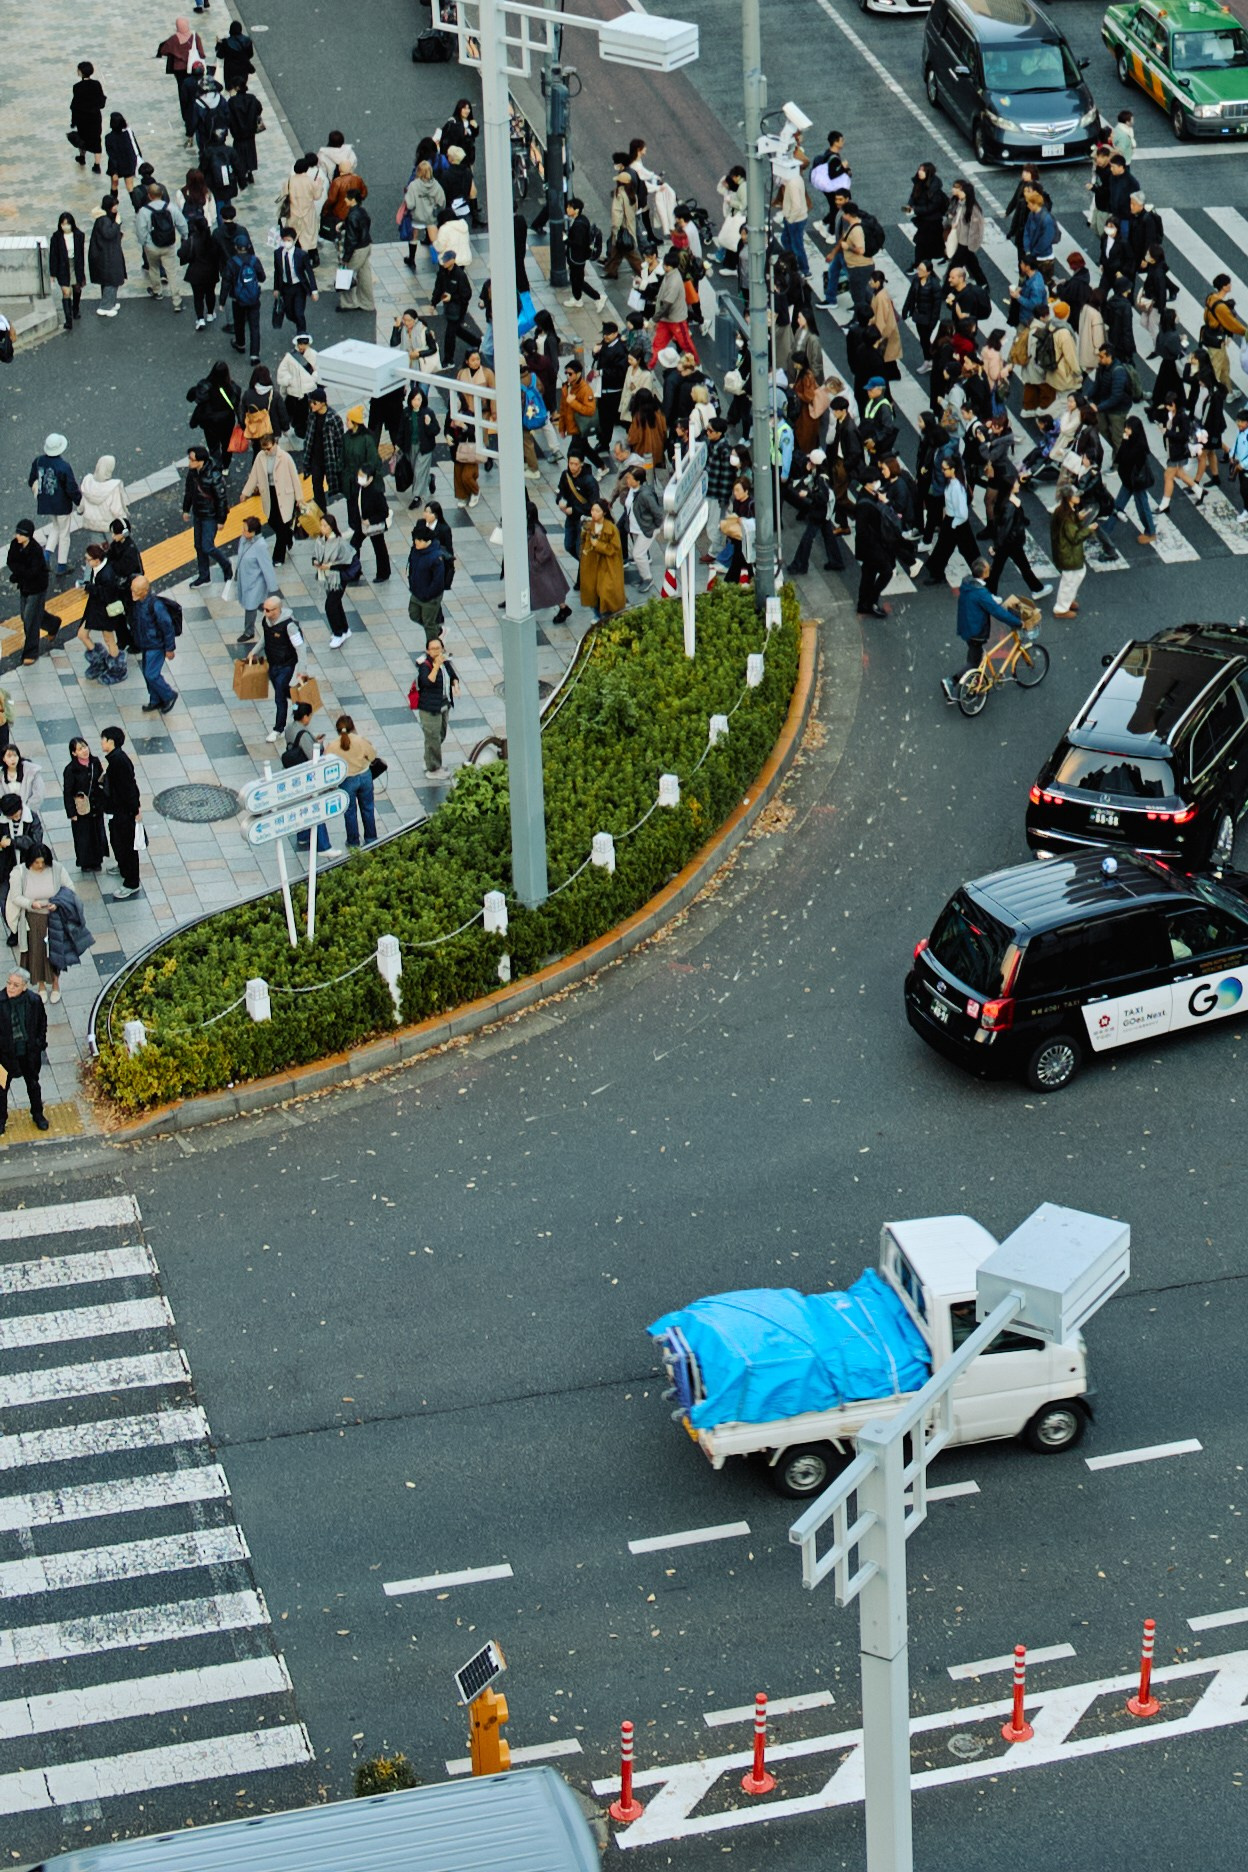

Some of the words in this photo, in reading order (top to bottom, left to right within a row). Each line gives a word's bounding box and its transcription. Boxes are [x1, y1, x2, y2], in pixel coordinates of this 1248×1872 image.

[1188, 977, 1243, 1016] GO
[1123, 1016, 1145, 1027] GOes
[1147, 1010, 1166, 1020] Next
[1124, 1006, 1144, 1017] TAXI
